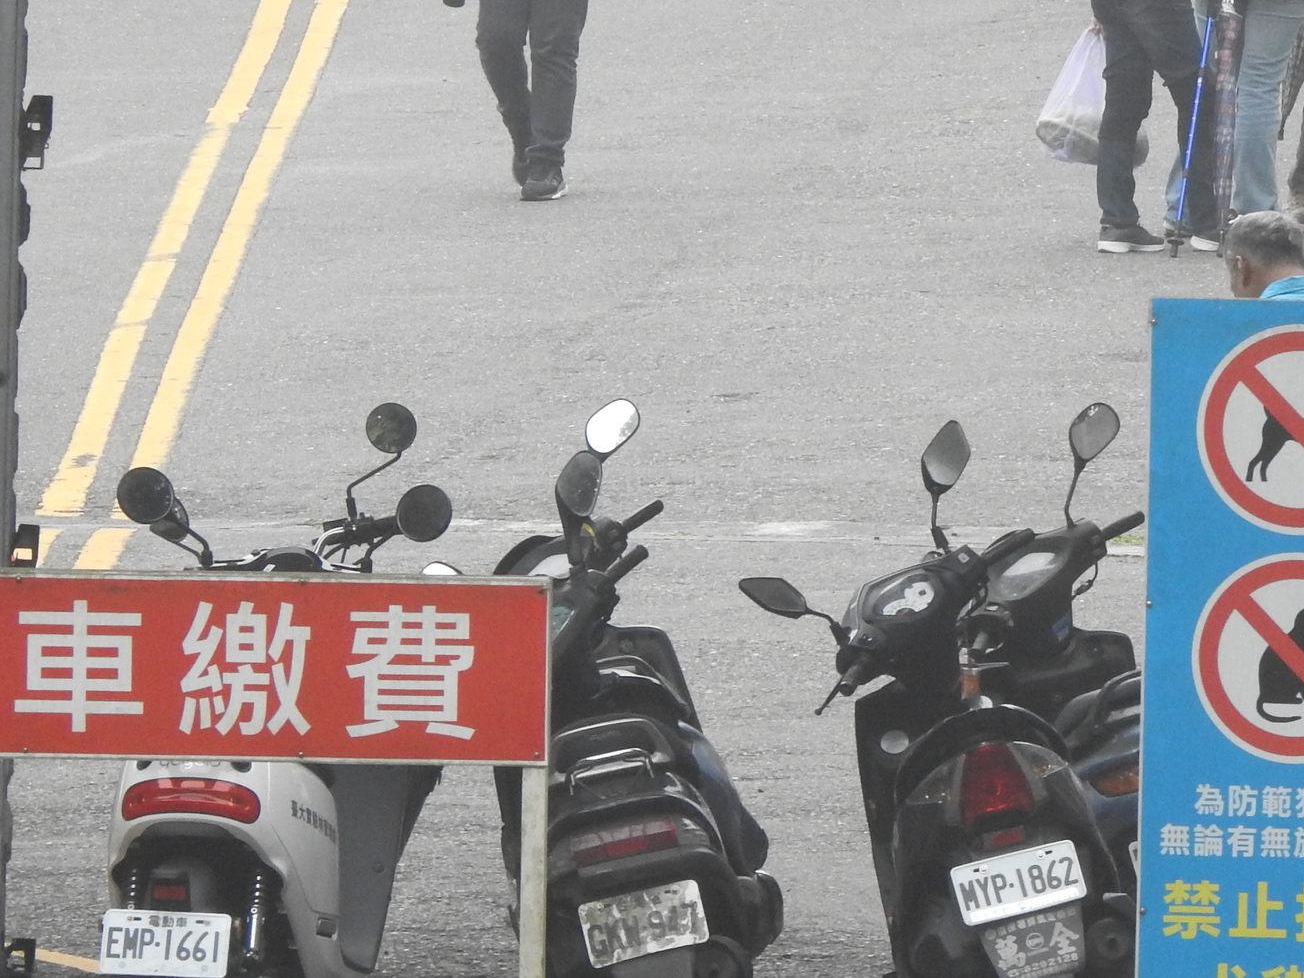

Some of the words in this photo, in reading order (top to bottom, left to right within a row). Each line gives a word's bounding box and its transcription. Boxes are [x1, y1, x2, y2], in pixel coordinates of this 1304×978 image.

[14, 600, 475, 740] 車繳費
[148, 914, 188, 928] 電動車
